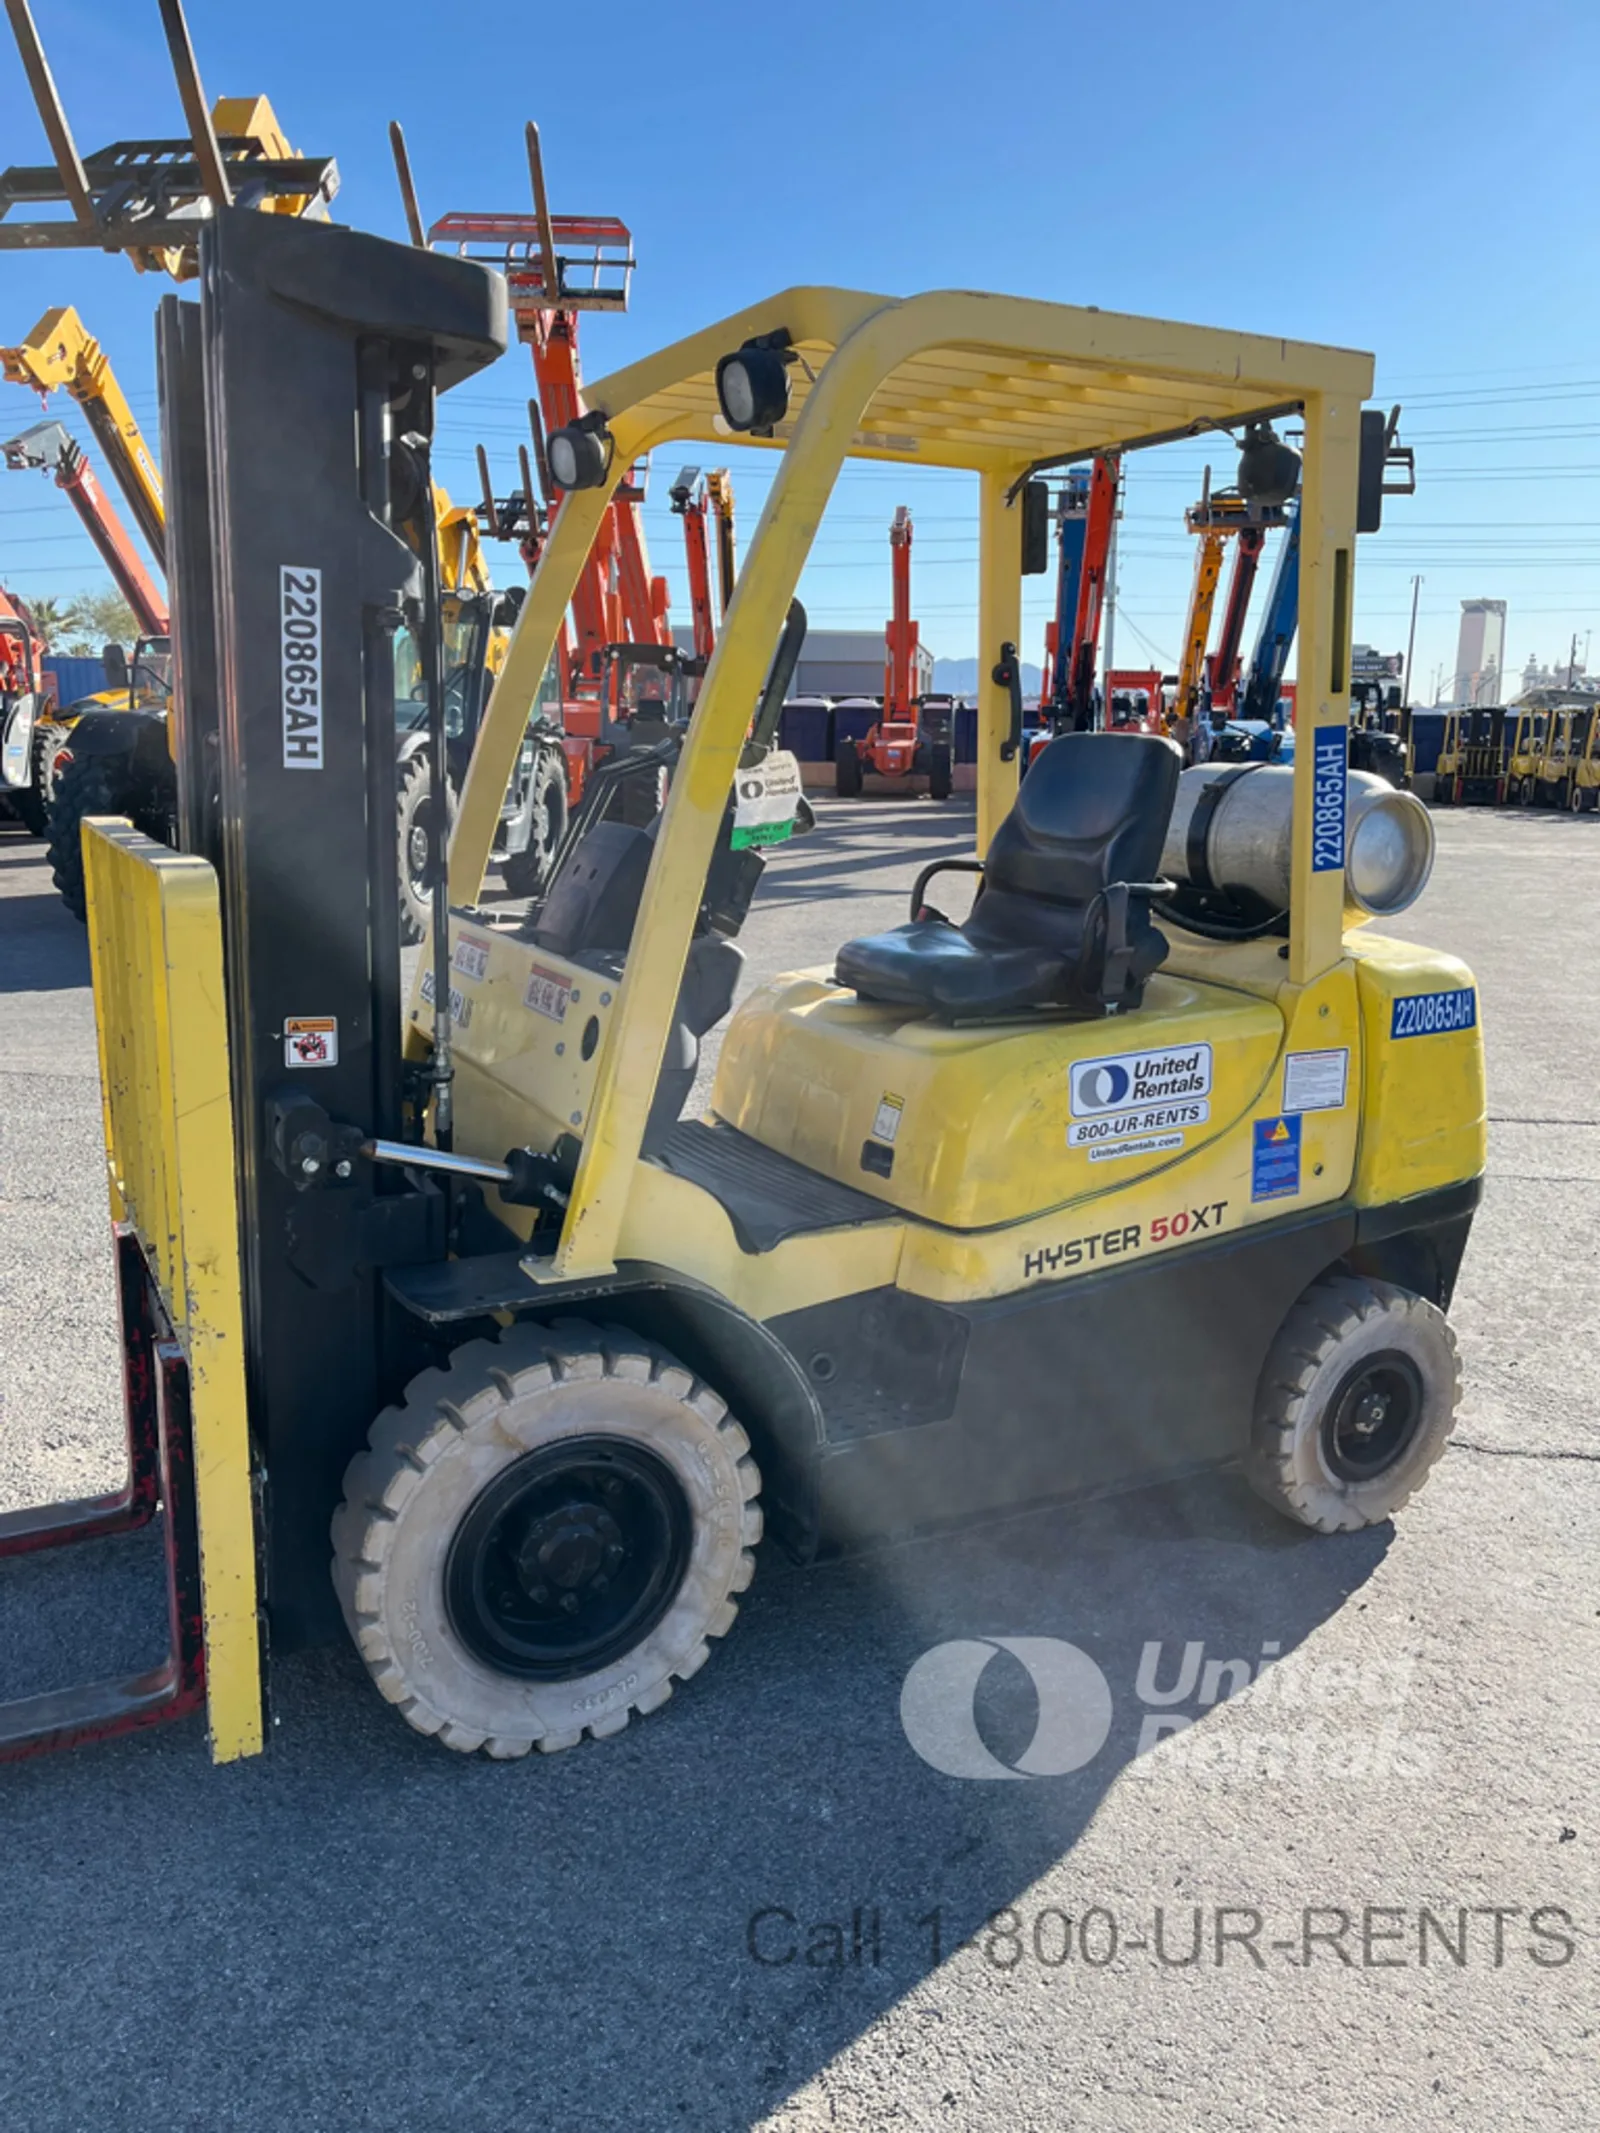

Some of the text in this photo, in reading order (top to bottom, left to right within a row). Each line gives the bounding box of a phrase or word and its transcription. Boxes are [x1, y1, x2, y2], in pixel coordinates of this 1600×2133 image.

[283, 571, 319, 760] 220865AH
[1314, 743, 1344, 866] 220865AH
[1396, 991, 1472, 1035] 220865AH
[1132, 1073, 1205, 1101] Rentals
[1134, 1052, 1200, 1080] United
[1076, 1105, 1200, 1141] 800-UR-RENTS
[1024, 1200, 1229, 1278] HYSTER 50XT
